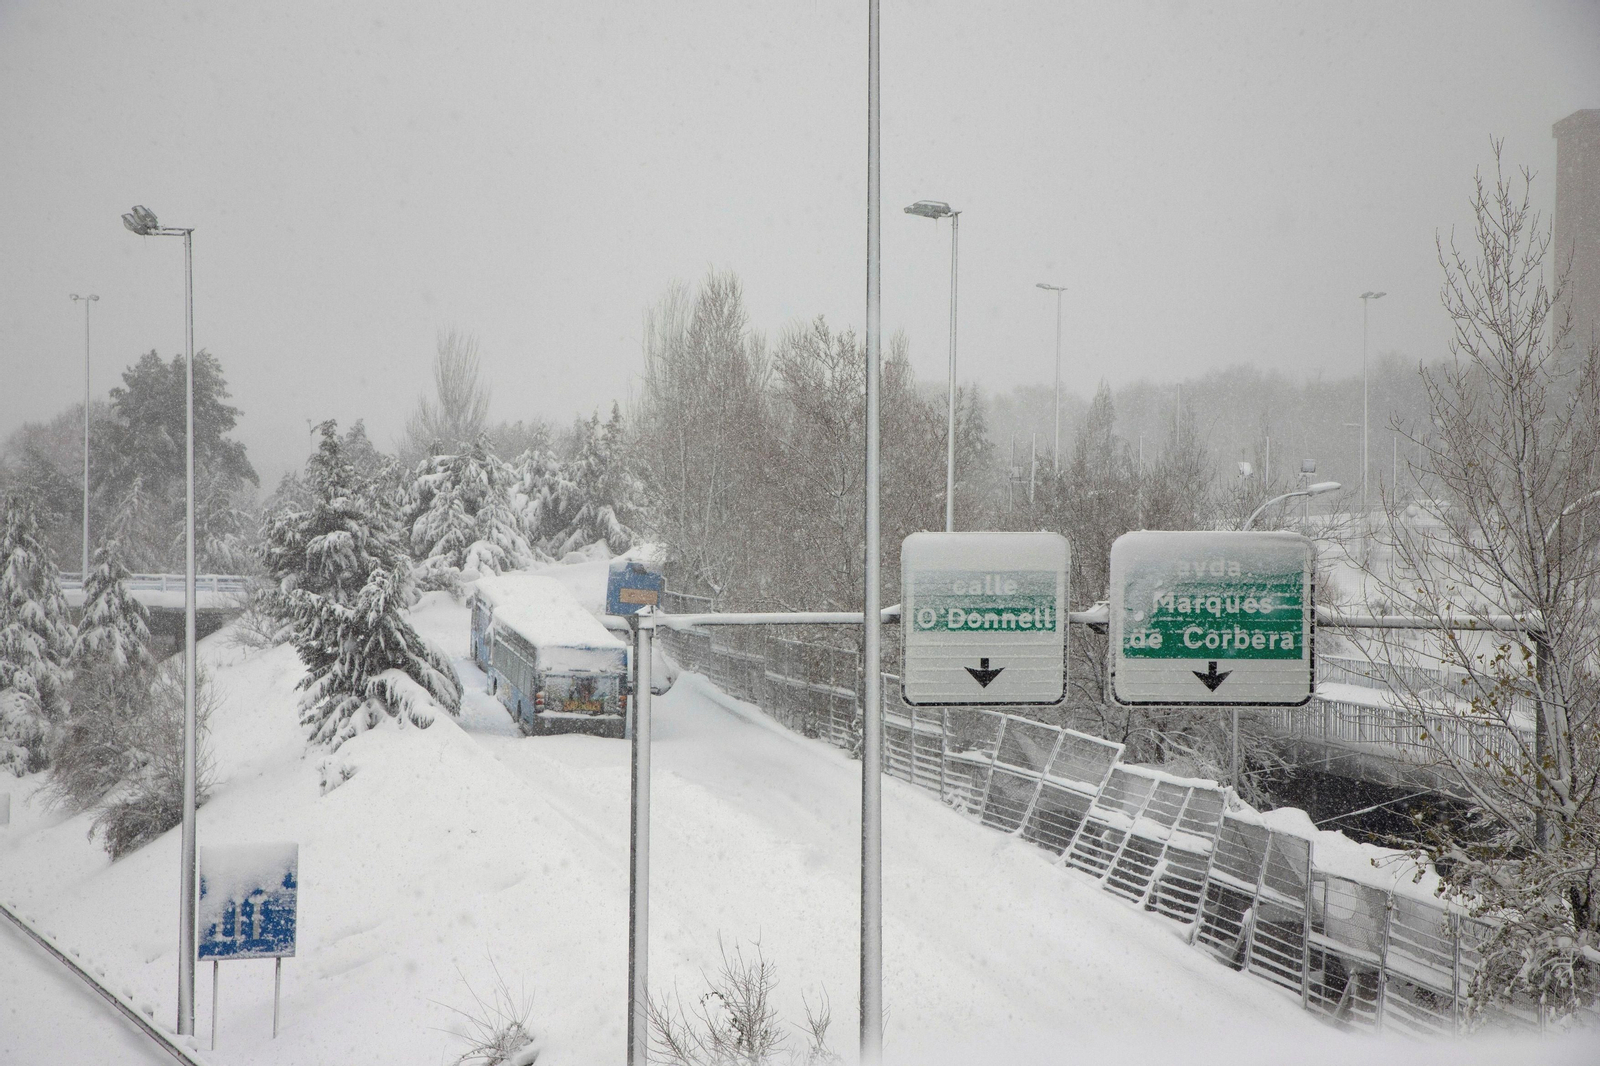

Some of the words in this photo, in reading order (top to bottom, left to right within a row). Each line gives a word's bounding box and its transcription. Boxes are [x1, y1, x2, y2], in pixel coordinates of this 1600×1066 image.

[952, 574, 1018, 596] calle
[917, 607, 1053, 629] O'Donnell
[1130, 627, 1164, 649] de
[1183, 626, 1294, 650] Corbera
